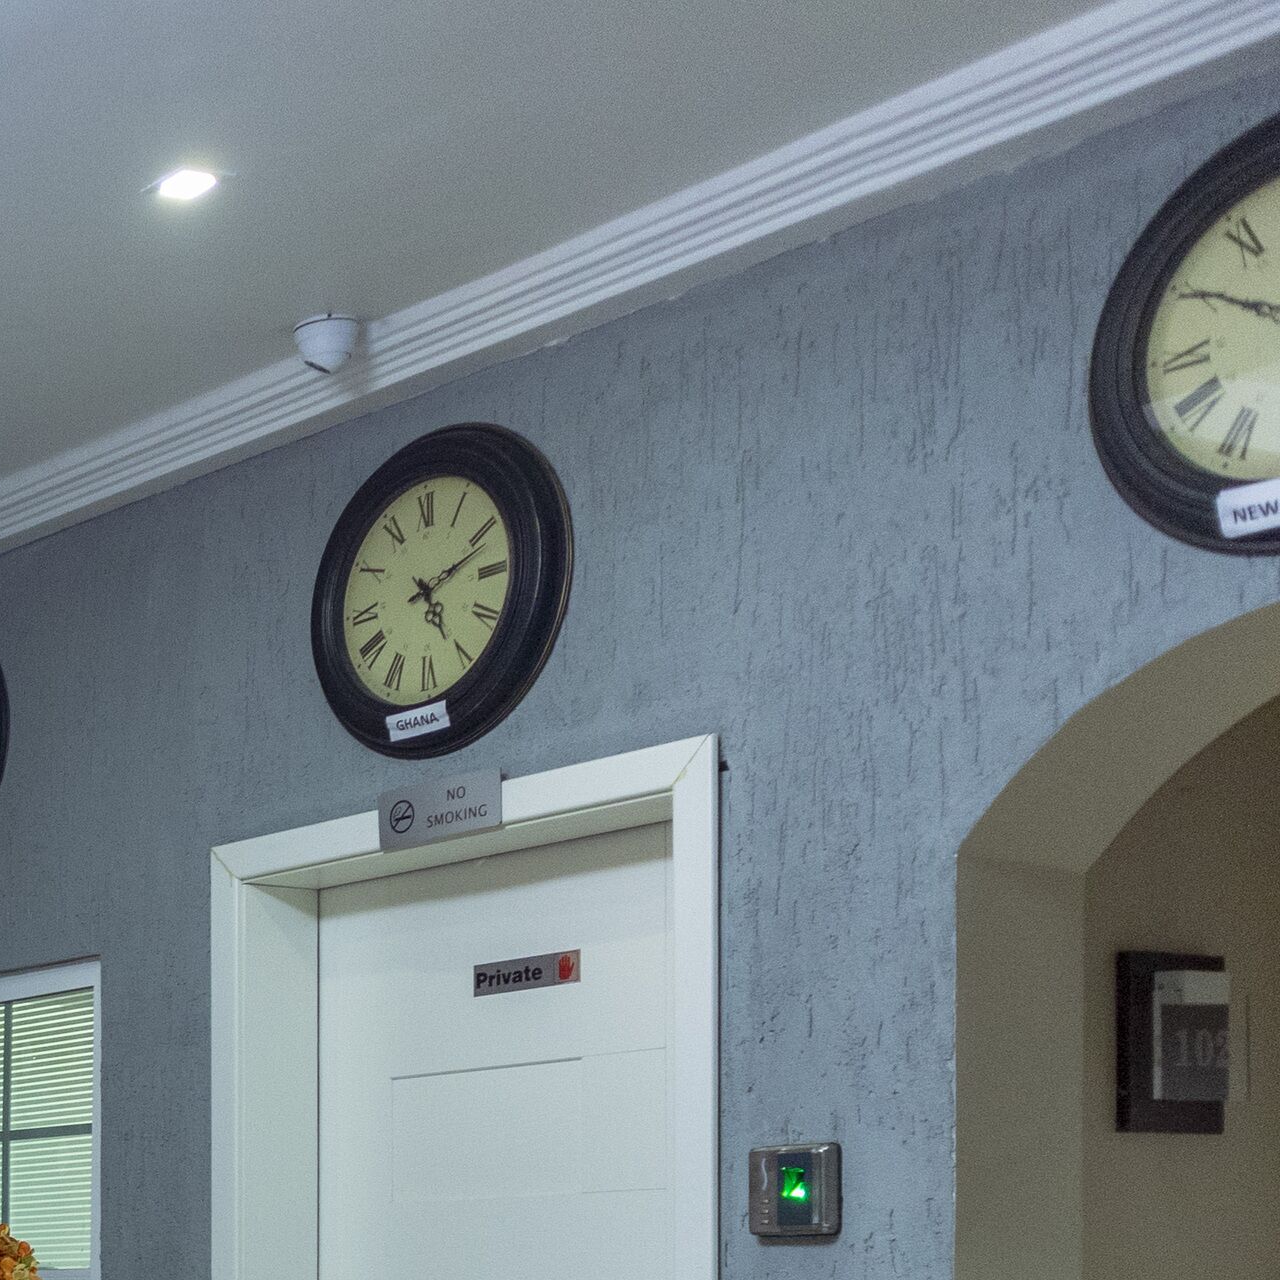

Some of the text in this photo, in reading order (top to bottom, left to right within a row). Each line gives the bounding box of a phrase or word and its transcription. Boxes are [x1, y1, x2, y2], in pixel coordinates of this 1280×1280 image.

[416, 490, 435, 533] XII
[1233, 500, 1279, 524] NEW
[396, 713, 439, 732] GHANA
[446, 786, 466, 801] NO
[426, 804, 488, 829] SMOKING
[475, 966, 543, 989] Private
